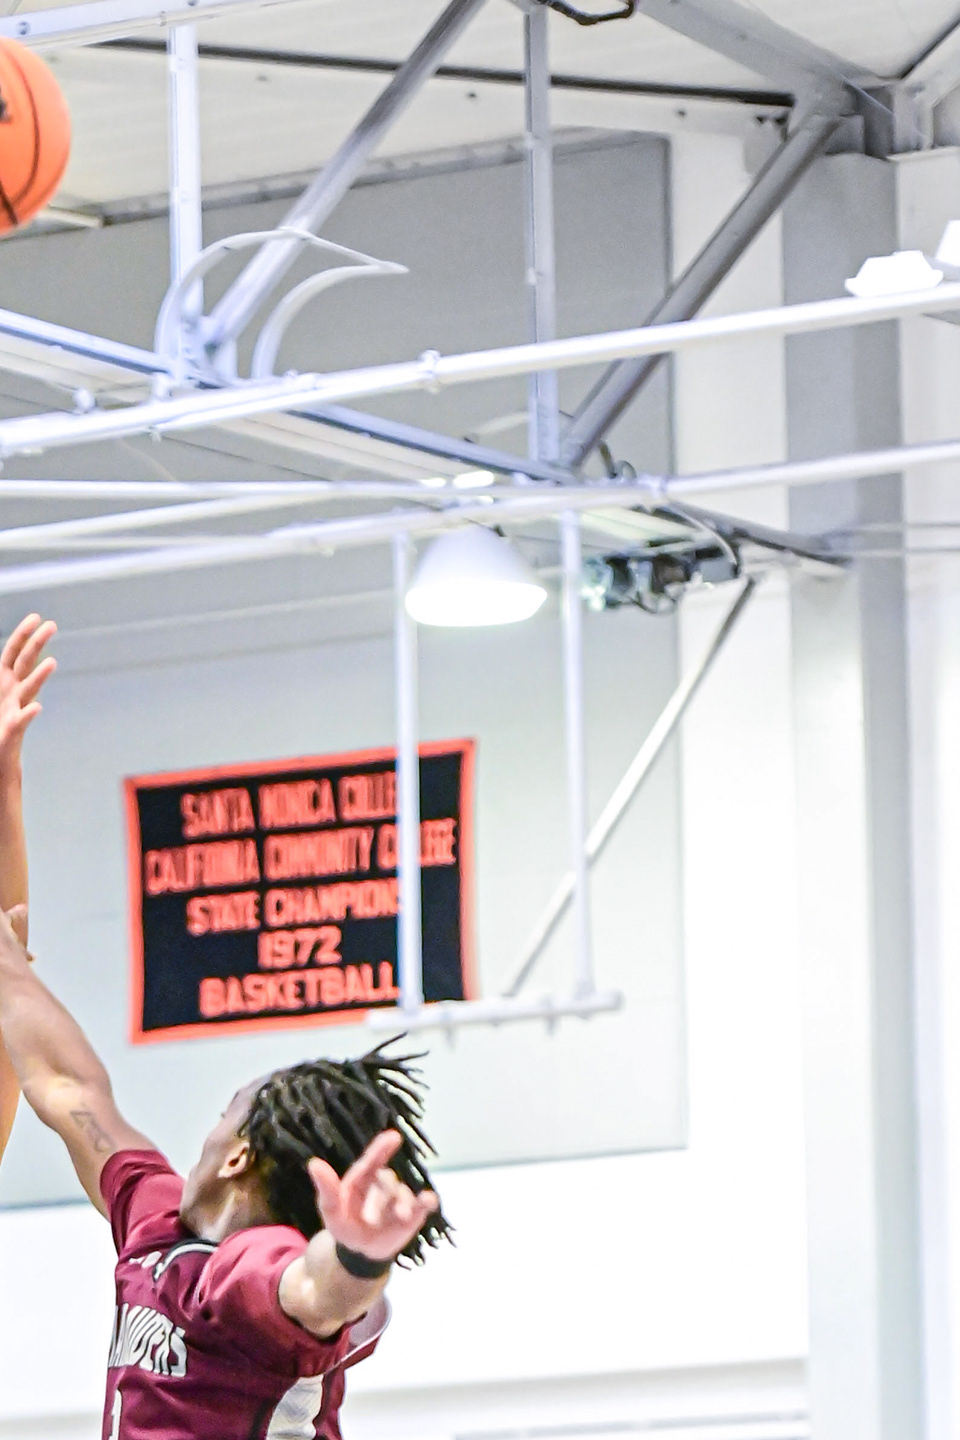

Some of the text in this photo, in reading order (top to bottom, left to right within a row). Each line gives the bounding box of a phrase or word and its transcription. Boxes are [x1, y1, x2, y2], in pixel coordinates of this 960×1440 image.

[180, 787, 255, 839] SANTA
[186, 876, 400, 936] STATE CHAMPION
[257, 925, 342, 969] 1972
[199, 960, 400, 1019] BASKETBALL
